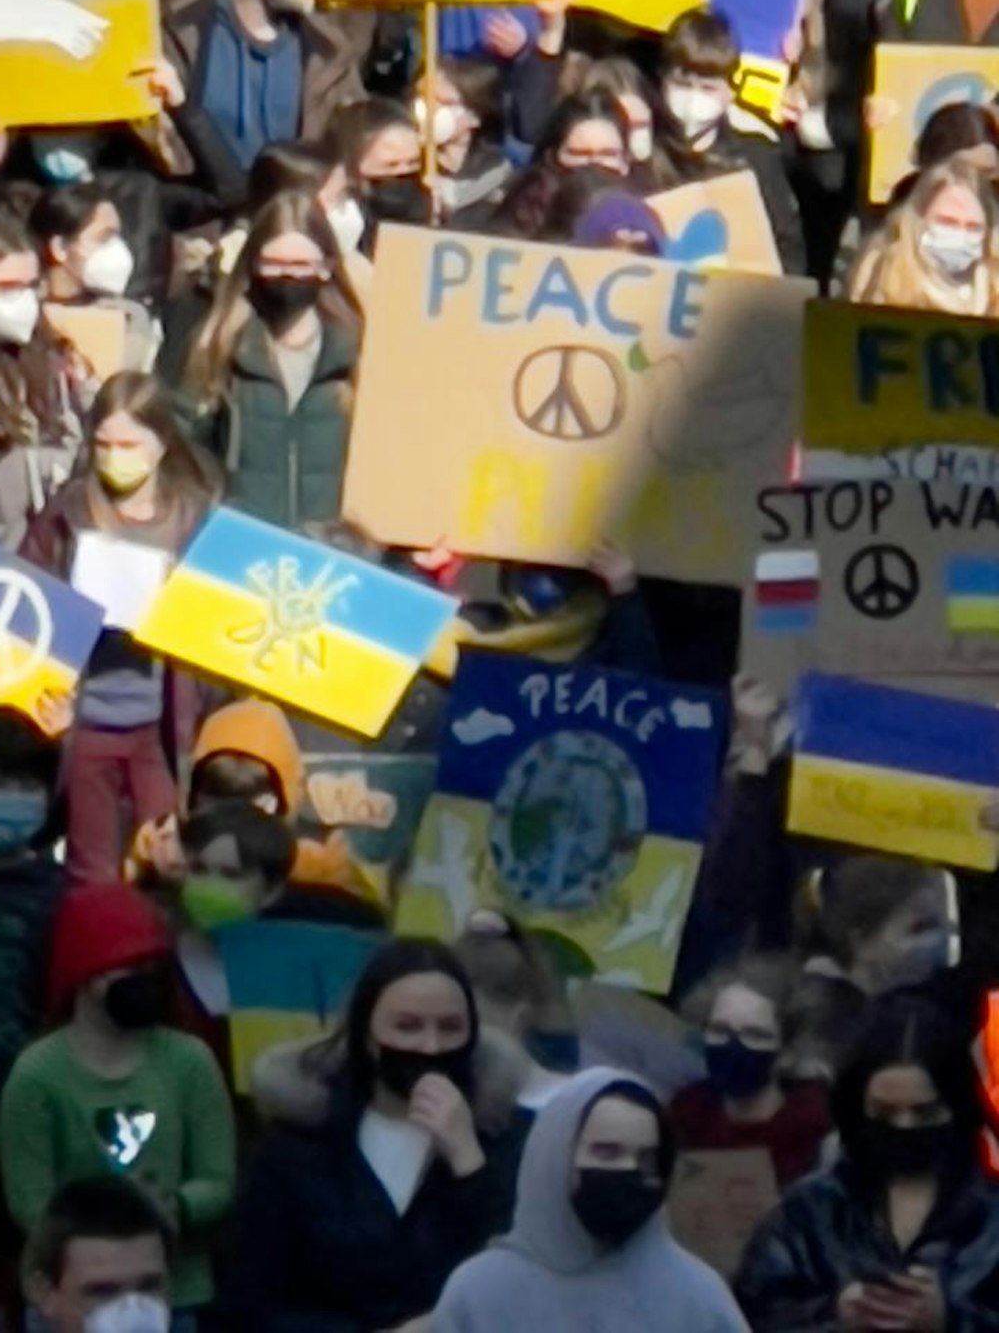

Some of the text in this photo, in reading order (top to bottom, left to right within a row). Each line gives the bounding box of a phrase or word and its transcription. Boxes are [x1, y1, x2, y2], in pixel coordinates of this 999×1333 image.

[427, 241, 708, 339] PEACE
[756, 479, 893, 544] STOP
[518, 673, 666, 743] PEACE
